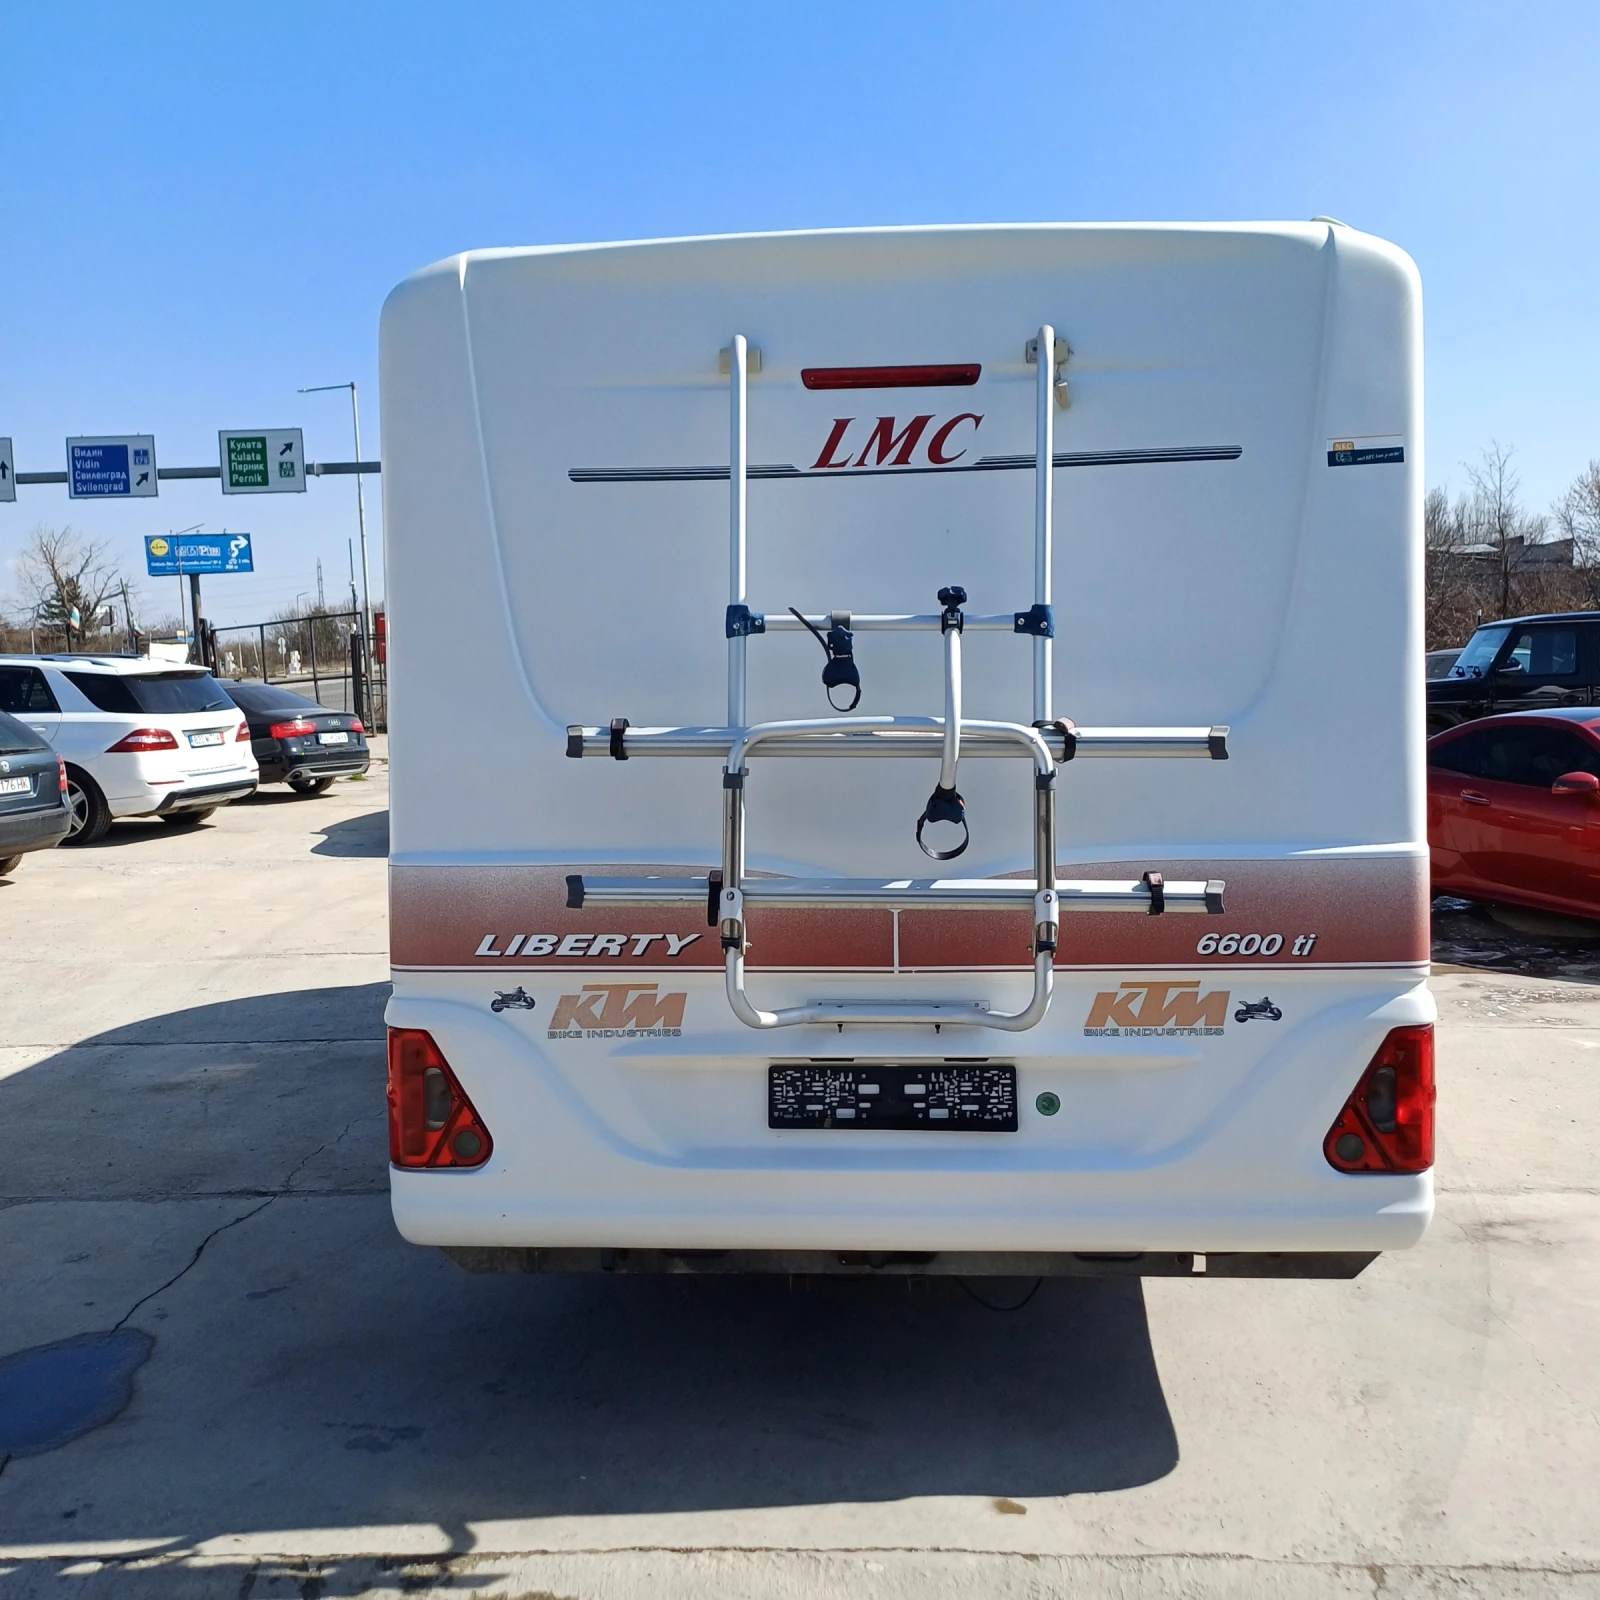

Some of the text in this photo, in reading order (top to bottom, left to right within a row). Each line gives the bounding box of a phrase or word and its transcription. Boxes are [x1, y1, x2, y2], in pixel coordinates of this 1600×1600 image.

[230, 440, 262, 450] Кулата
[810, 412, 984, 469] LMC
[74, 447, 103, 457] Видин
[231, 452, 262, 461] Kulata
[75, 459, 100, 469] Vidin
[231, 462, 265, 472] Перник
[75, 470, 127, 480] Свиленград
[232, 474, 263, 483] Pernik
[76, 481, 124, 493] Svilengrad
[473, 933, 703, 957] LIBERTY
[1196, 932, 1318, 957] 6600 ti
[548, 983, 688, 1029] KTM
[1085, 980, 1231, 1028] KTM
[547, 1029, 682, 1040] BIKE INDUSTRIES
[1083, 1027, 1225, 1037] BIKE INDUSTRIES
